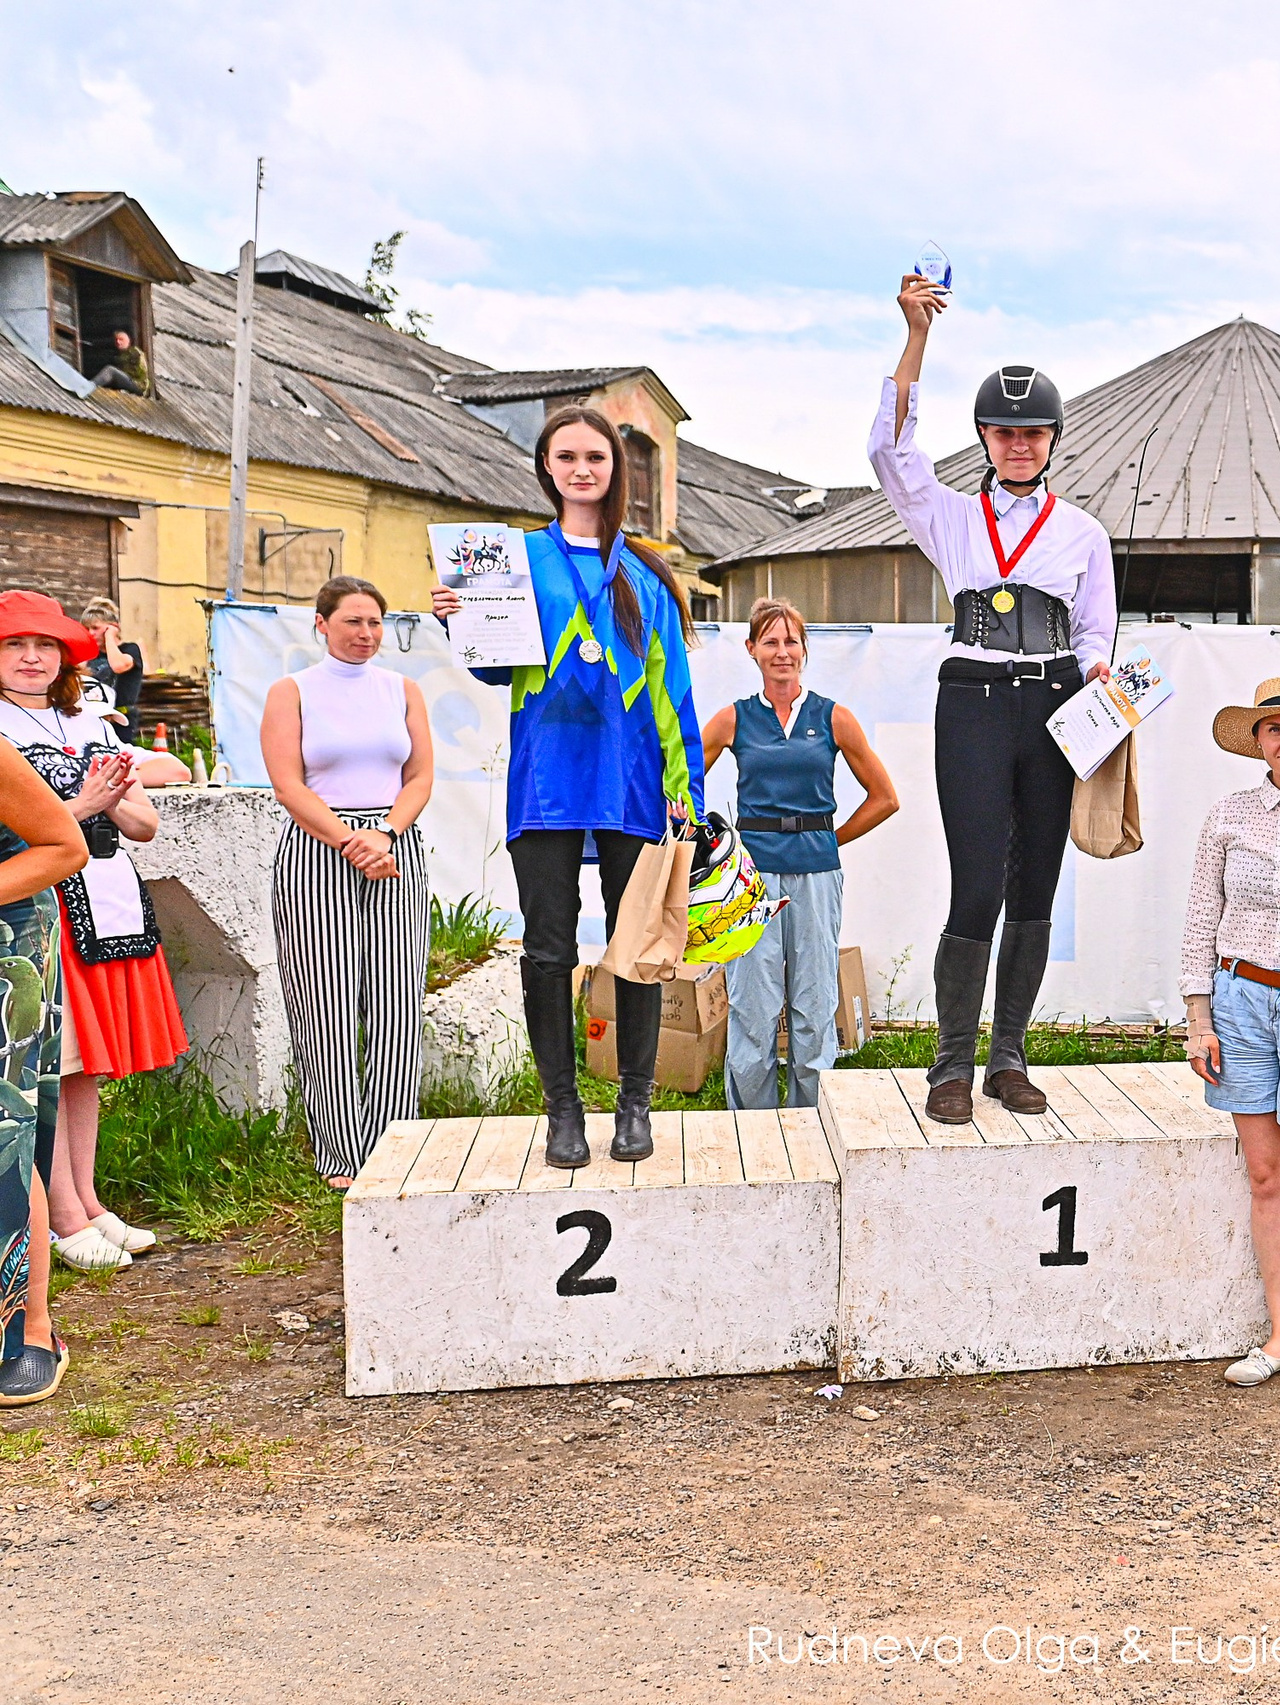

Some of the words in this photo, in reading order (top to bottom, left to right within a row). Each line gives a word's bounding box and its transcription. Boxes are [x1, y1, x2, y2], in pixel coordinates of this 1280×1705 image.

[1107, 683, 1128, 712] РАМОТА
[556, 1210, 617, 1297] 2
[1040, 1186, 1089, 1267] 1
